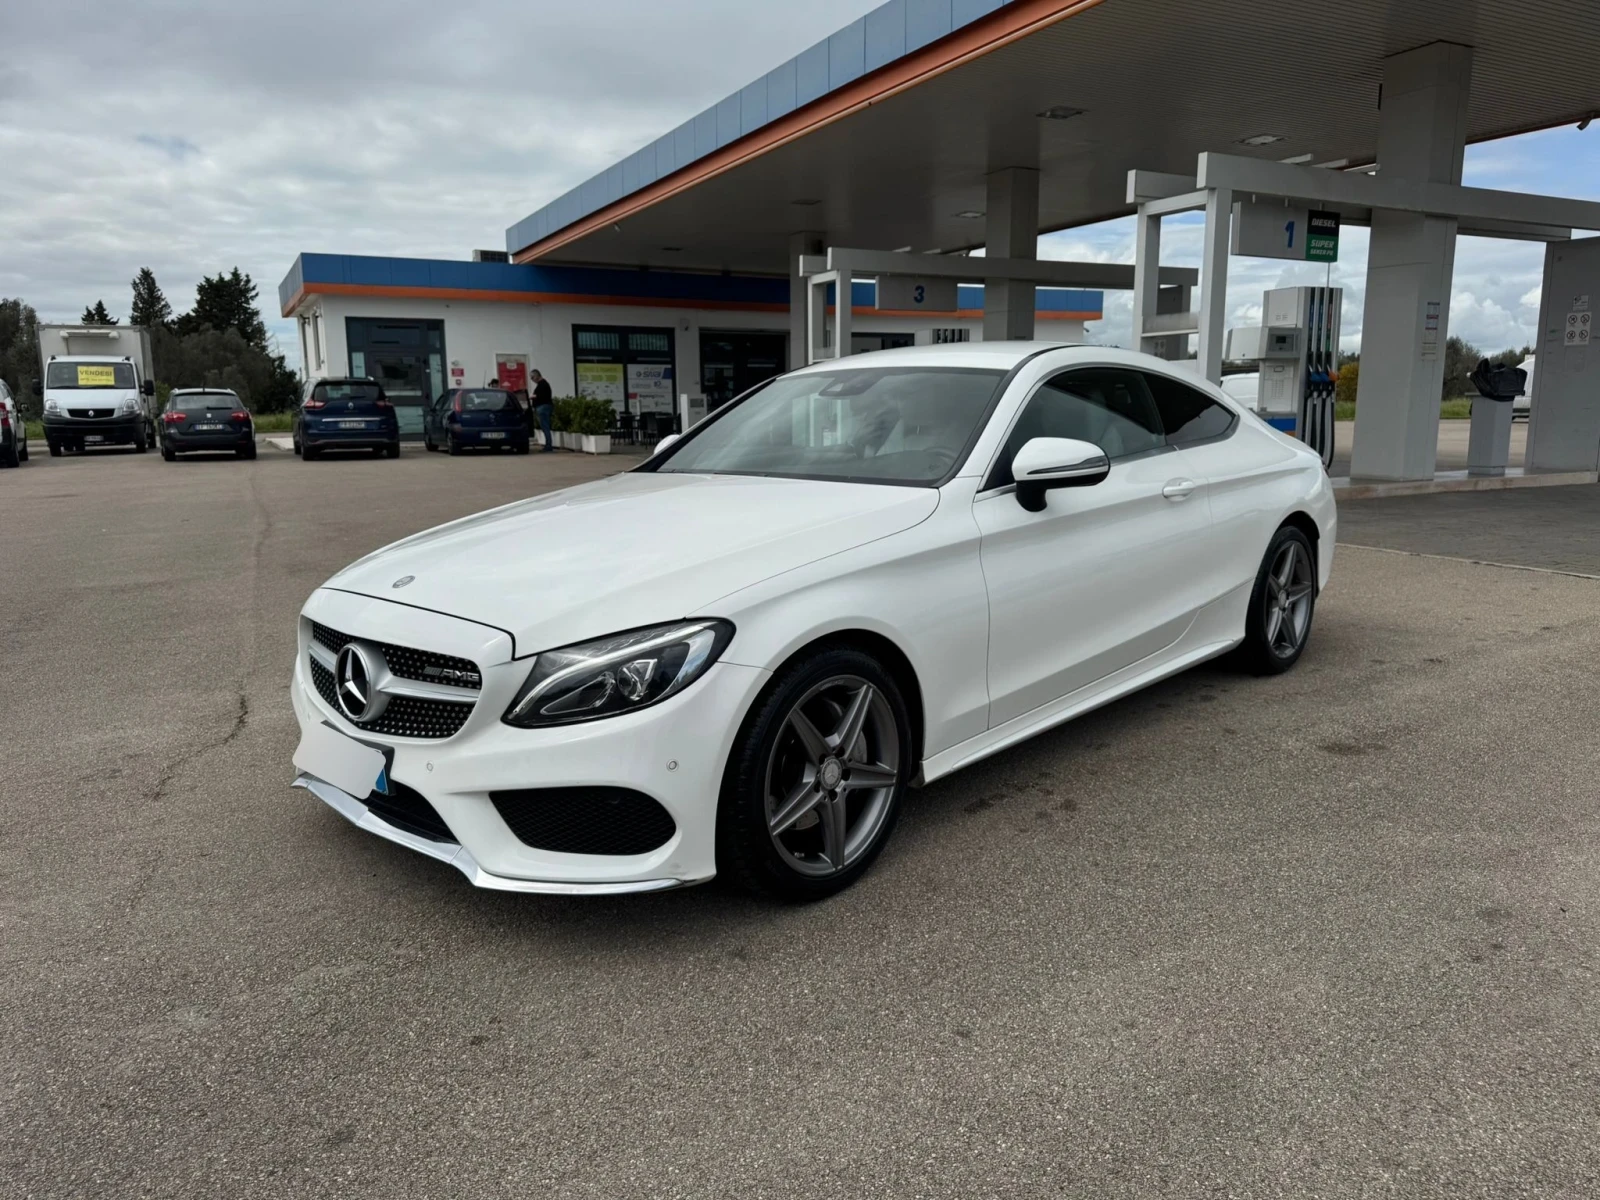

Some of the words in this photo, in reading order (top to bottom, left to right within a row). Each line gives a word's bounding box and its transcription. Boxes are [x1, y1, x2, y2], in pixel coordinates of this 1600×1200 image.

[1311, 218, 1336, 228] DIESEL
[1285, 220, 1295, 248] 1
[1310, 239, 1335, 248] SUPER
[914, 285, 925, 303] 3
[440, 669, 480, 682] AMG
